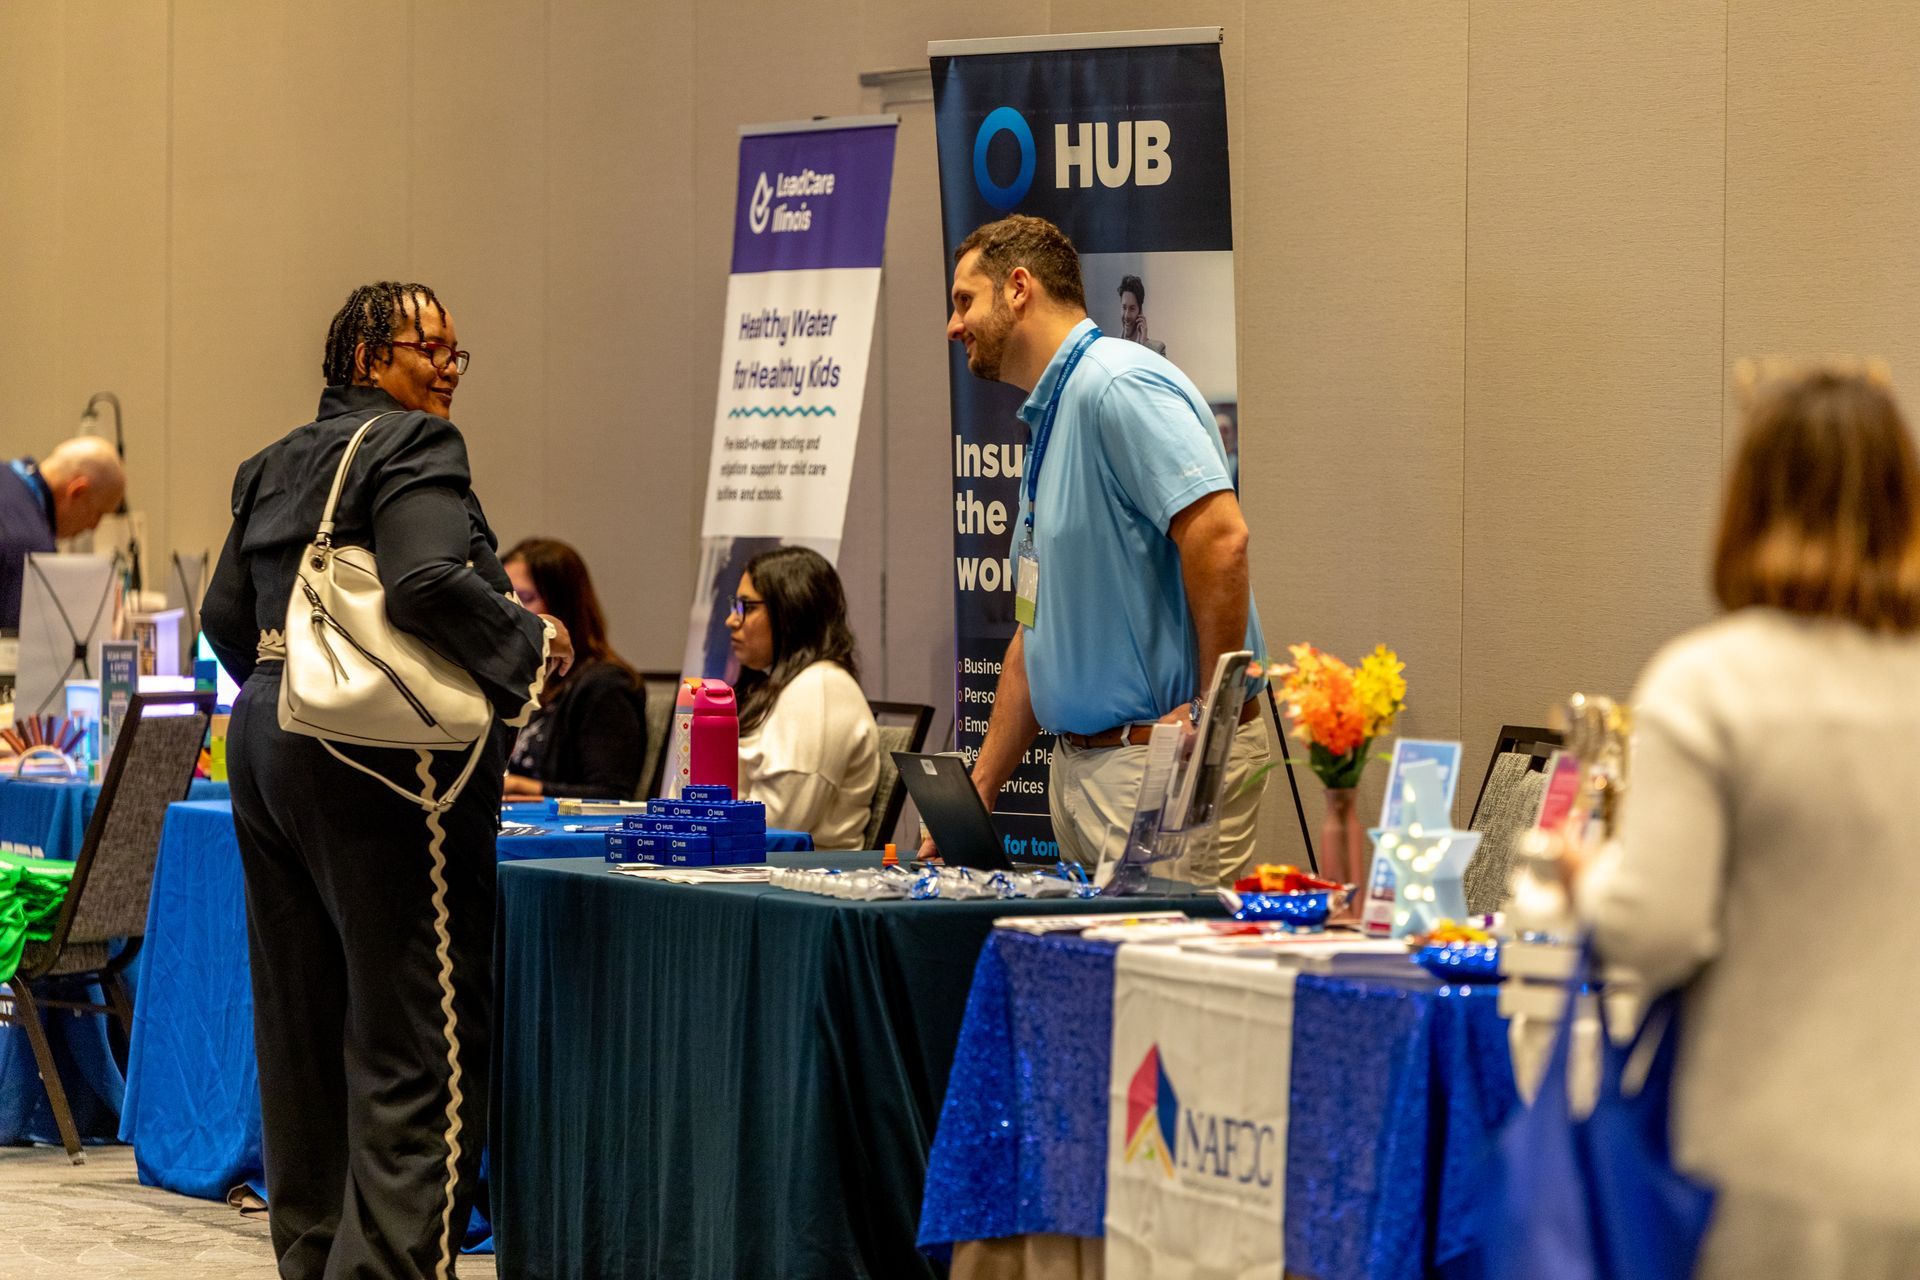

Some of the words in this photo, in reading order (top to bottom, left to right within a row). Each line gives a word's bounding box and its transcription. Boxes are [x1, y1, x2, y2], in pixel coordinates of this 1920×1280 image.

[1054, 119, 1172, 189] HUB
[776, 168, 835, 198] LeadCare
[771, 202, 812, 233] Illinois
[738, 307, 791, 347] Healthy
[791, 309, 838, 337] Water
[732, 360, 751, 390] for
[751, 358, 805, 396] Healthy
[806, 354, 842, 388] Kids
[955, 434, 1024, 478] Insu
[955, 489, 1008, 536] the
[956, 557, 1012, 592] wor
[964, 657, 1003, 675] Busine
[964, 687, 997, 704] Perso
[965, 716, 990, 736] Emp
[1034, 748, 1054, 765] Pla
[999, 777, 1045, 795] ervices
[1003, 834, 1027, 855] for
[1031, 837, 1060, 857] tom
